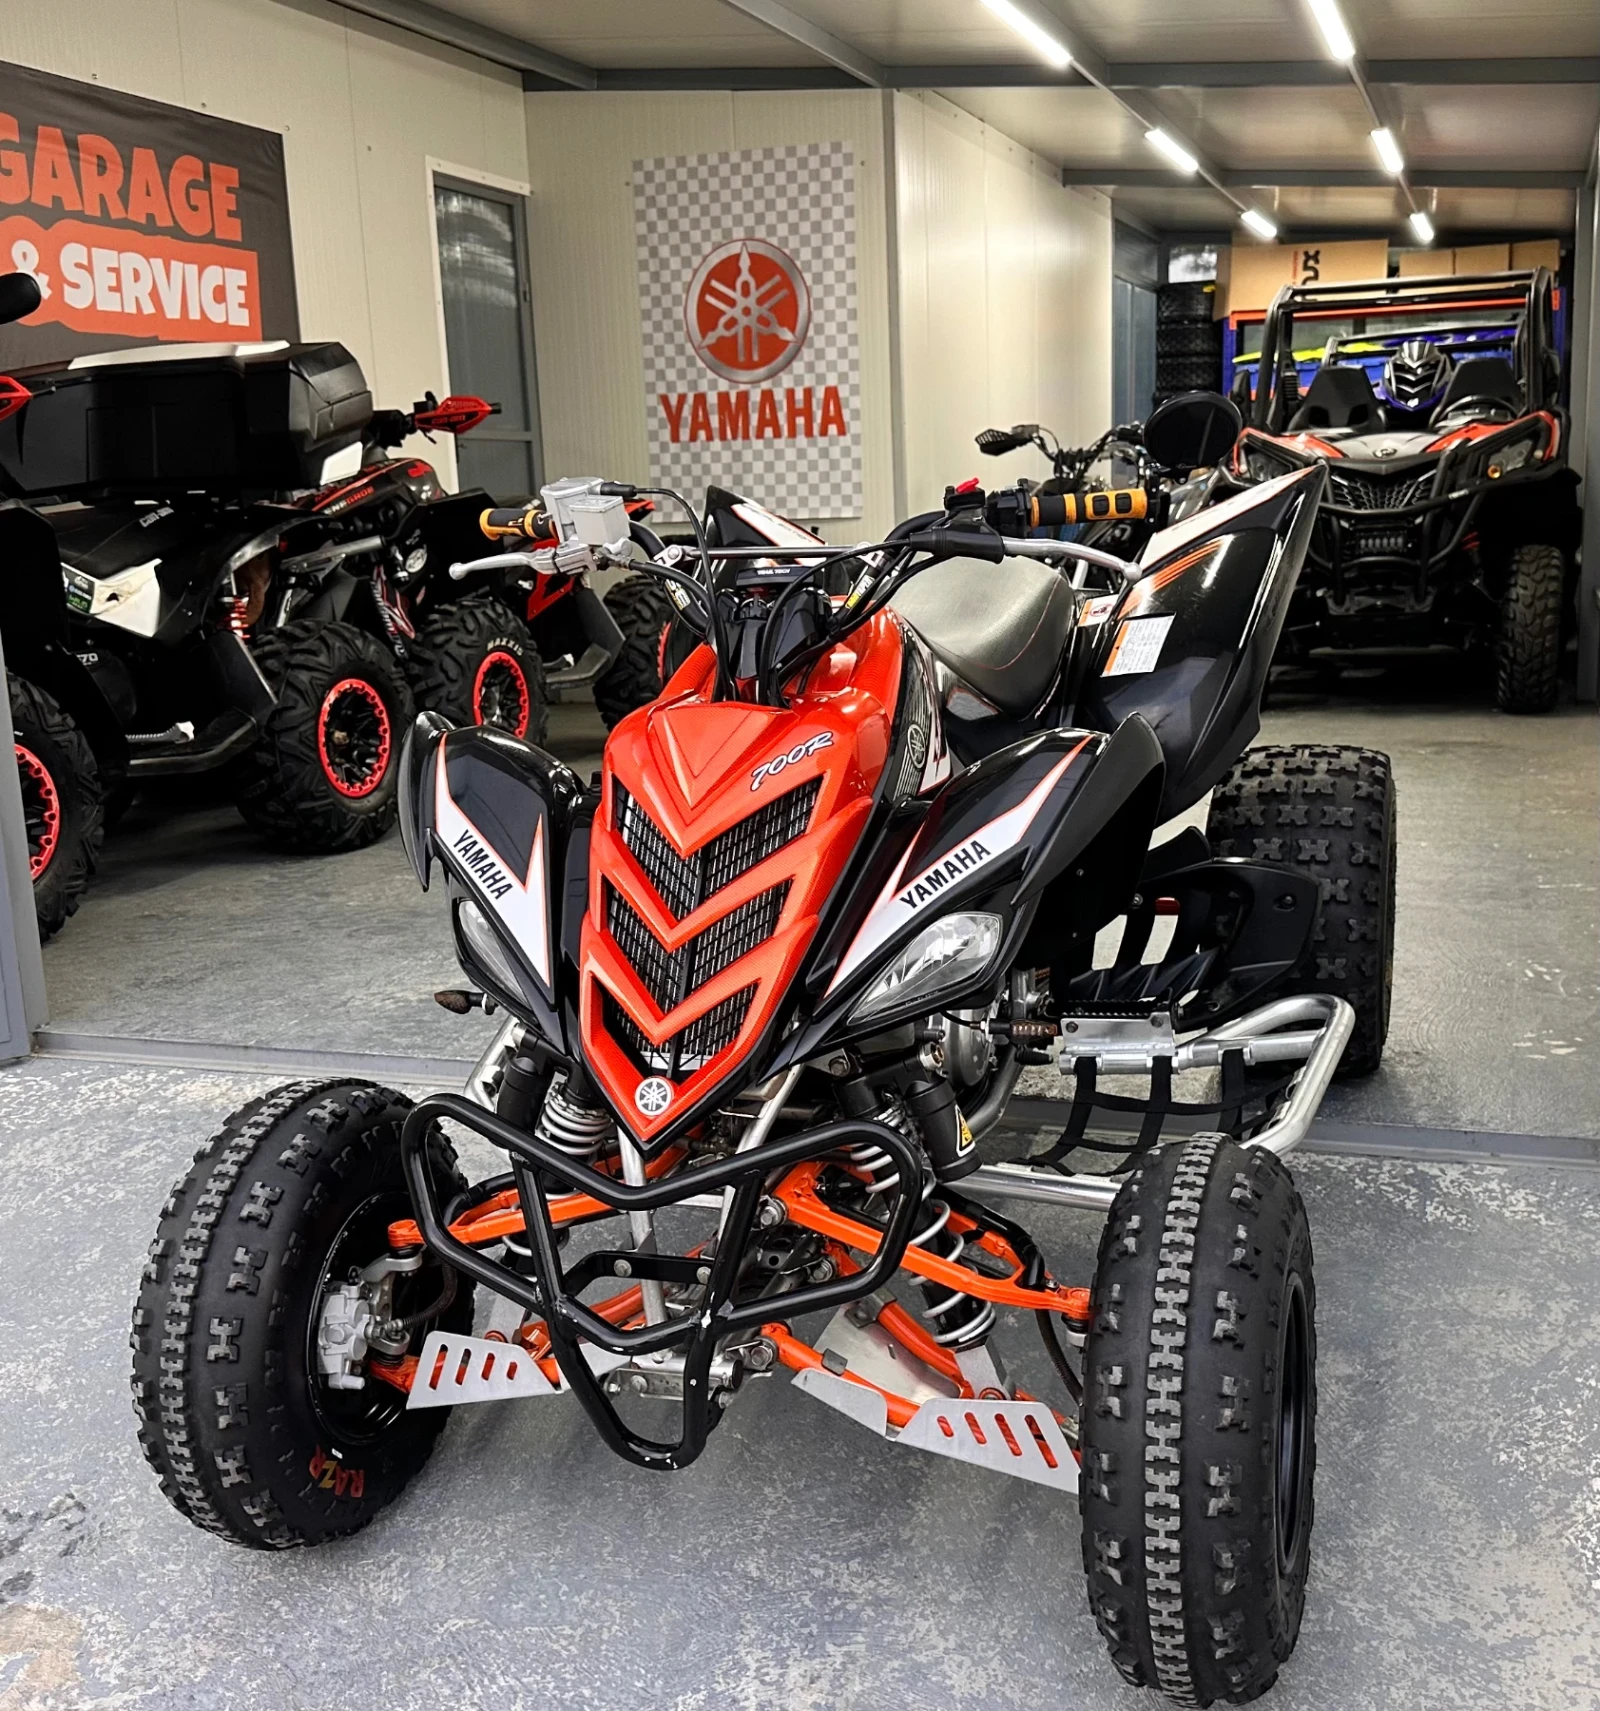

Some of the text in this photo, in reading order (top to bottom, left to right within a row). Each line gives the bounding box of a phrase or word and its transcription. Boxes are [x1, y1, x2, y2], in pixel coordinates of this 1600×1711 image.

[0, 112, 242, 241] GARAGE
[59, 242, 250, 326] SERVICE
[659, 386, 847, 443] YAMAHA
[750, 731, 833, 792] 700R
[453, 829, 514, 900] YAMAHA
[899, 839, 992, 909] YAMAHA
